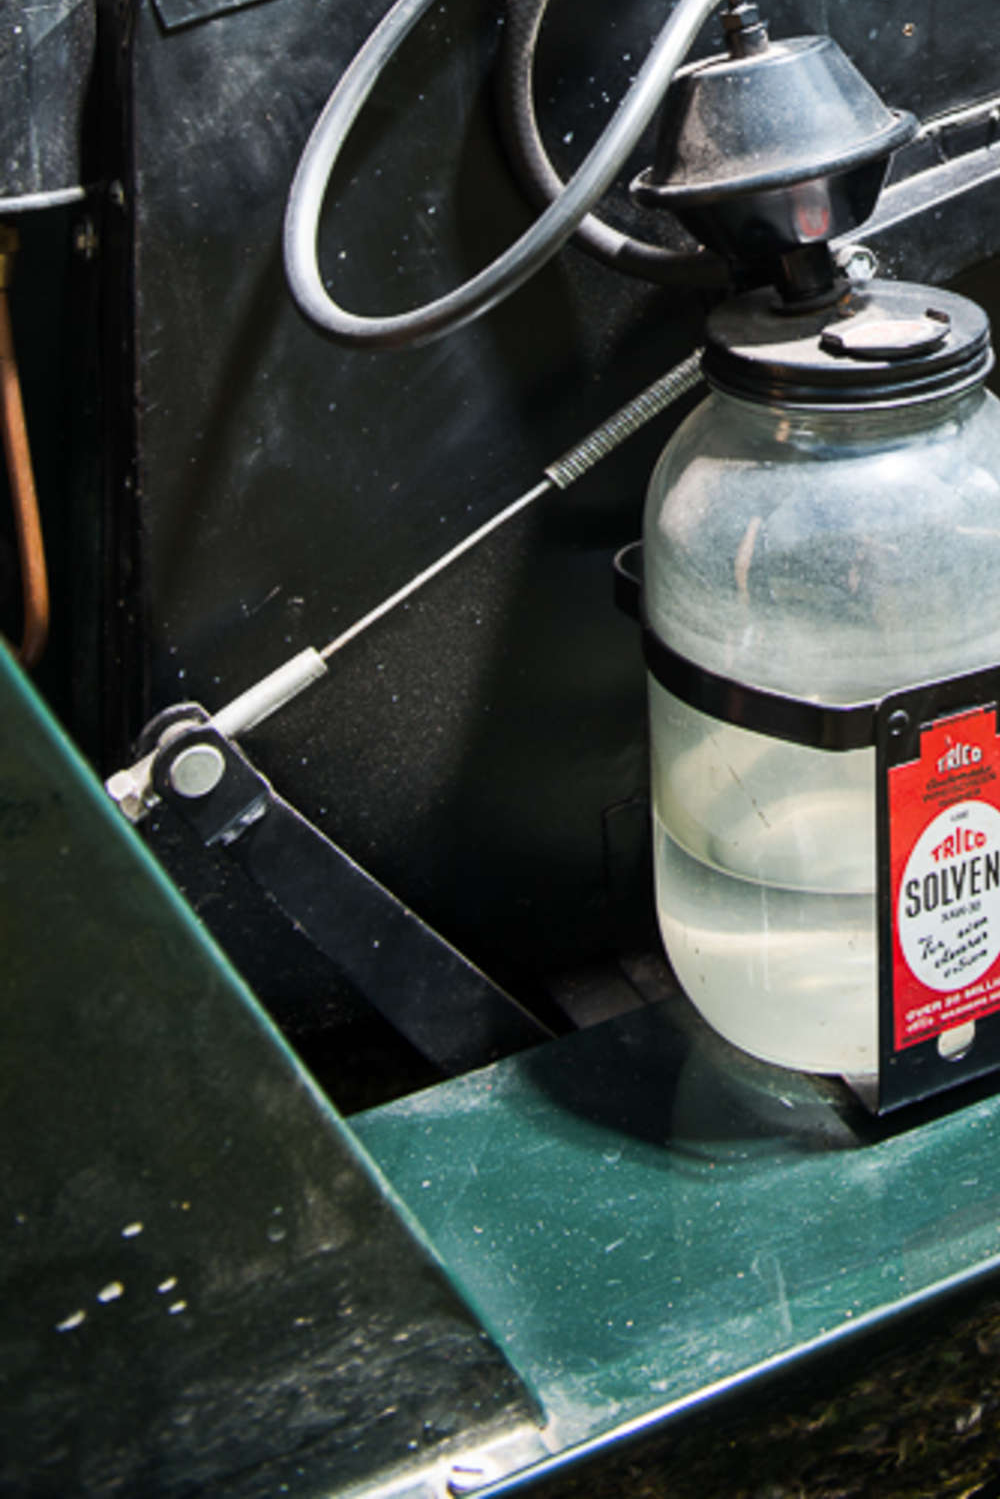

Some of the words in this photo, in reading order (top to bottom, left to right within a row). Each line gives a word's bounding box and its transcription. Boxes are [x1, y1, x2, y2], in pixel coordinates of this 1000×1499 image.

[938, 742, 982, 773] TRICO
[931, 827, 987, 862] TRICO
[905, 1001, 942, 1022] OVER
